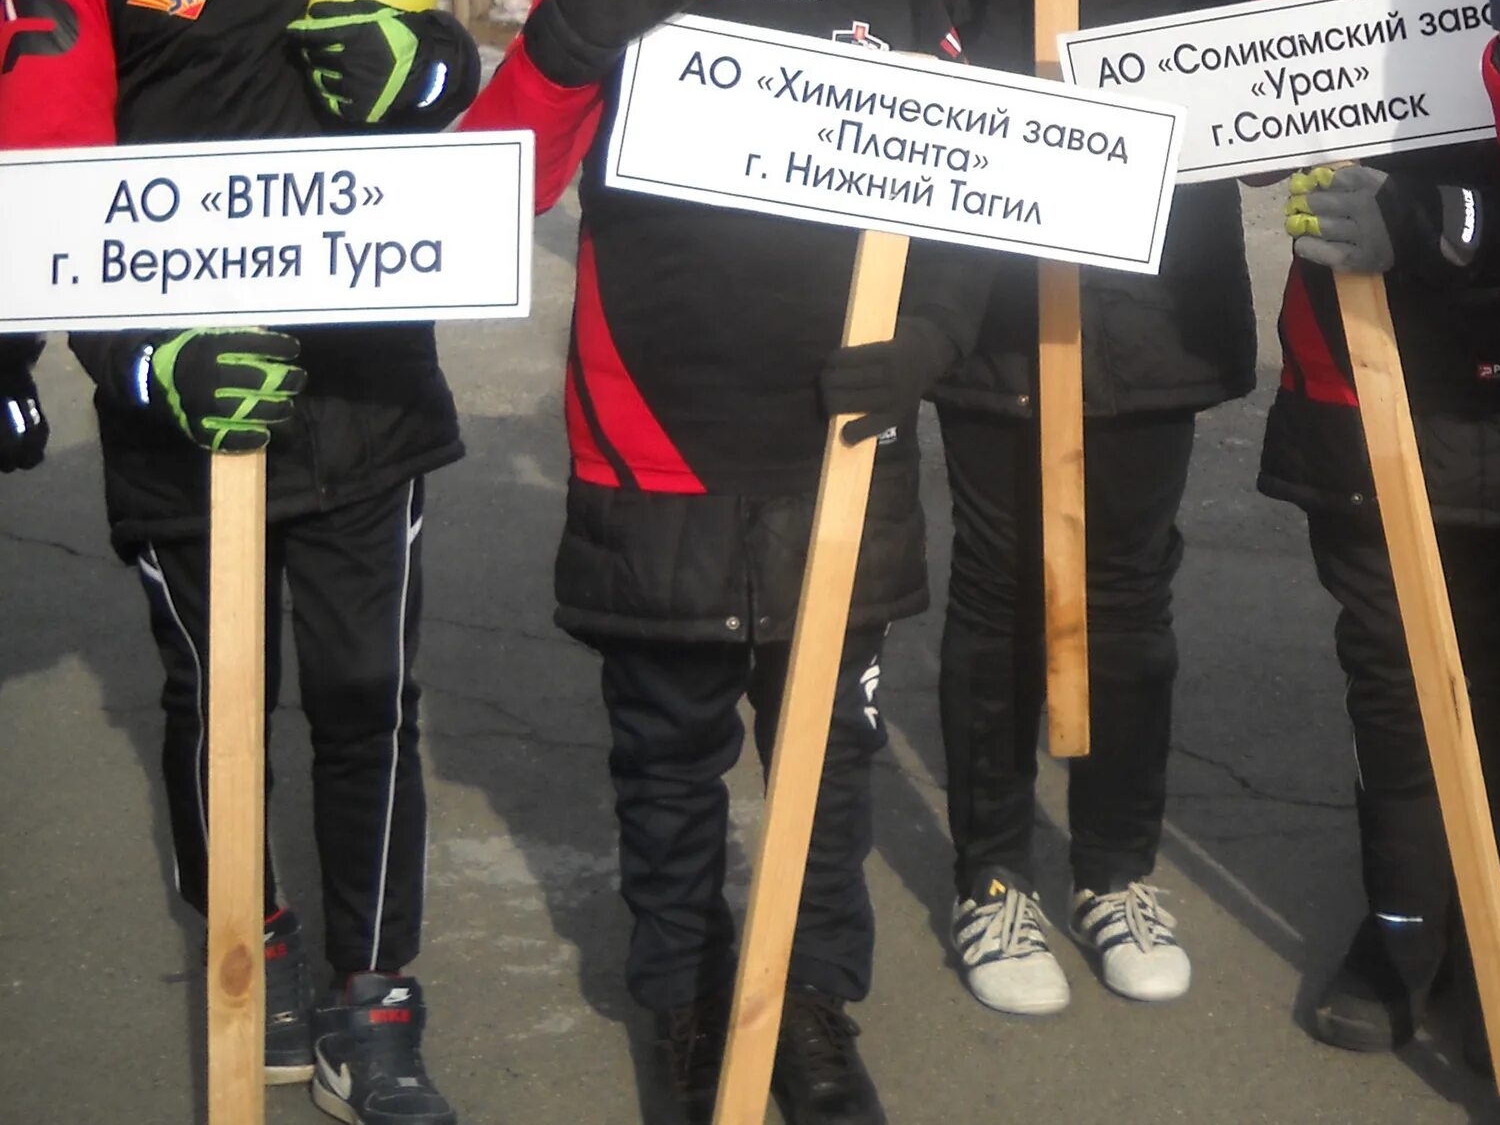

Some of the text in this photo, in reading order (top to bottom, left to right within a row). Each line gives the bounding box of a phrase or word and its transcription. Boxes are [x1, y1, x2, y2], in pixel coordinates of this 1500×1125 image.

[1098, 51, 1146, 88] АО
[1158, 10, 1408, 75] «Соликамский
[678, 50, 1130, 165] АО «Химический завод
[1251, 65, 1370, 105] «Урал»
[817, 119, 991, 173] «Планта»
[1211, 92, 1431, 147] г.Соликамск
[104, 169, 385, 224] АО «ВТМЗ»
[745, 151, 1043, 225] г. Нижний Тагил
[50, 230, 443, 294] г. Верхняя Тура
